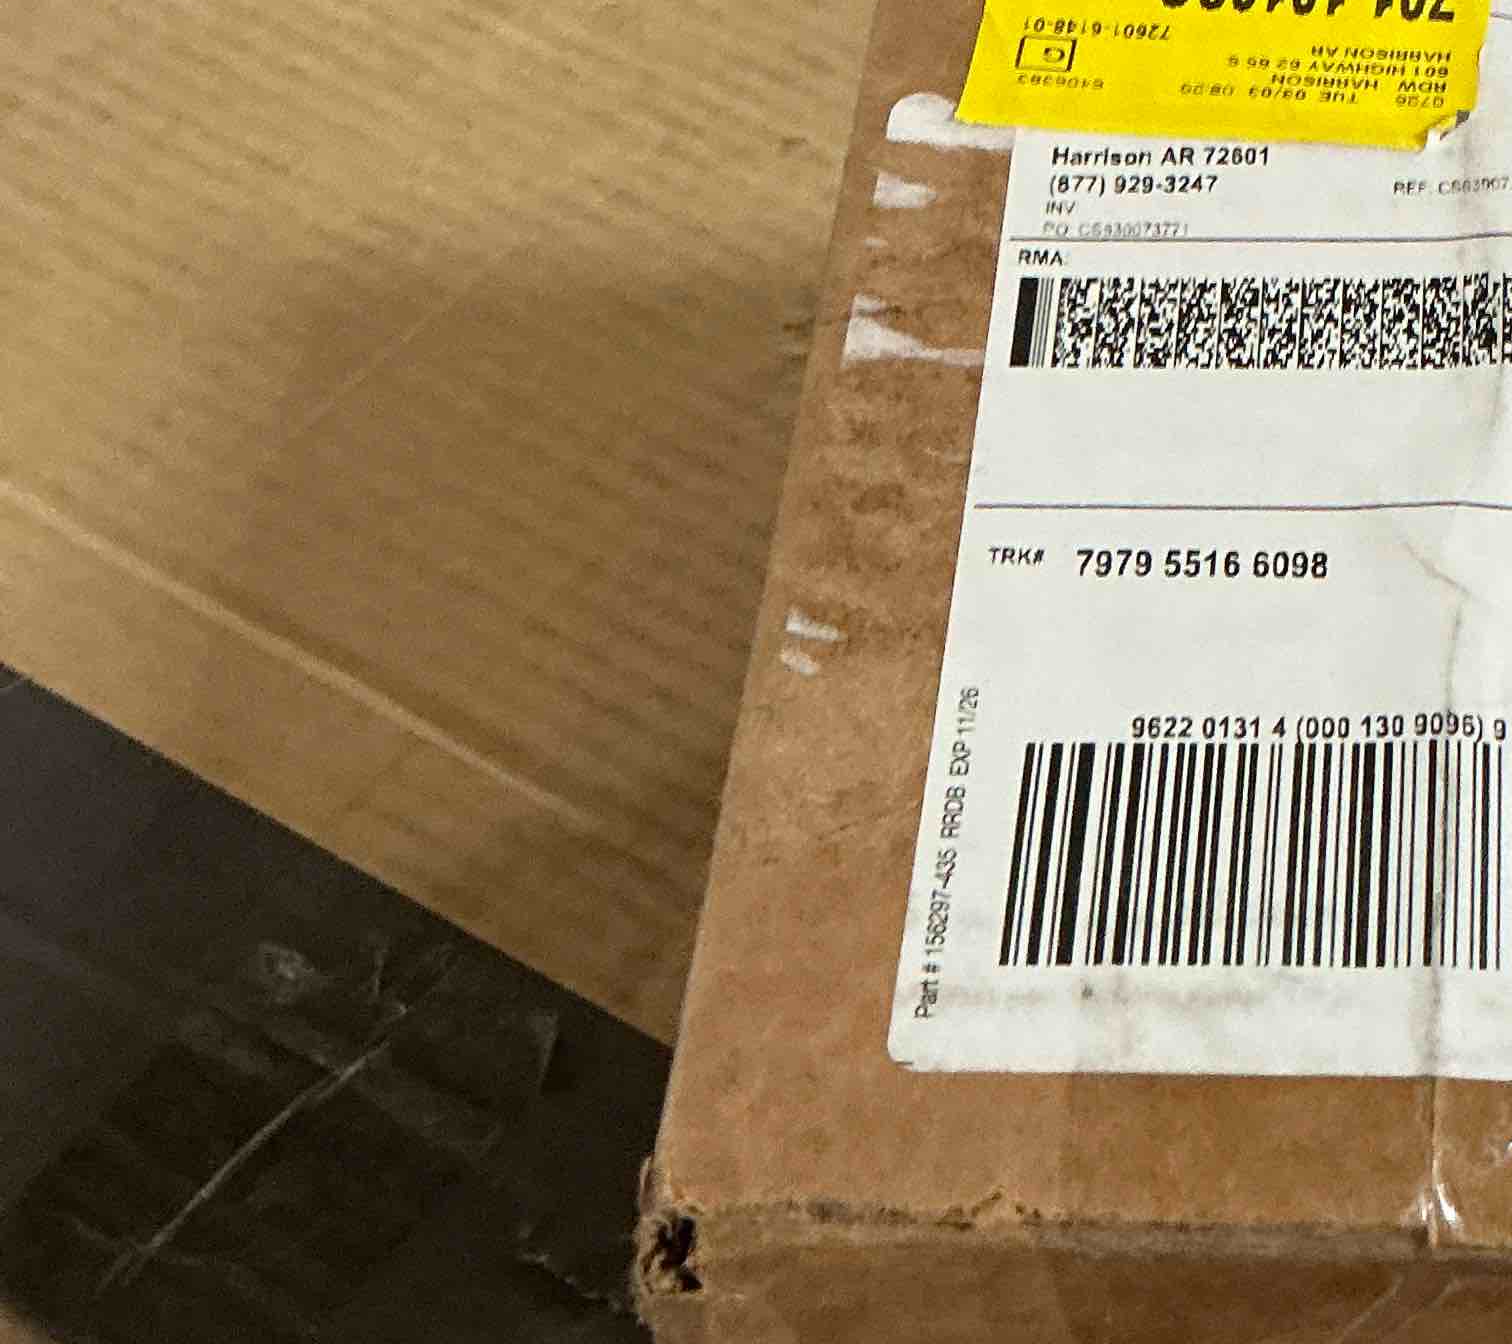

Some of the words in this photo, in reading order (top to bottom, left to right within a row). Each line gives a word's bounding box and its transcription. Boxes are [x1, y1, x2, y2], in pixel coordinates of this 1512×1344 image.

[1023, 15, 1172, 41] 72601-6148-01
[1310, 44, 1339, 58] AR
[1344, 47, 1452, 64] HARRISON
[1308, 60, 1406, 77] HIGHWAY
[1414, 65, 1450, 79] 601
[1271, 73, 1379, 91] HARRISON
[1397, 79, 1448, 94] RDW
[1319, 90, 1358, 105] TUE
[1051, 146, 1153, 167] Harrison
[1160, 146, 1195, 166] AR
[1204, 146, 1270, 166] 72601
[1049, 174, 1106, 198] (877)
[1113, 174, 1219, 194] 929-3247
[987, 547, 1045, 566] TRK#
[1076, 549, 1153, 578] 7979
[1164, 550, 1241, 578] 5516
[1252, 551, 1329, 579] 6098
[956, 685, 981, 736] 11/26
[1131, 714, 1193, 740] 9622
[1201, 715, 1260, 739] 0131
[1271, 715, 1287, 738] 4
[1296, 713, 1350, 744] (000
[1360, 713, 1405, 739] 130
[1413, 711, 1484, 744] 9096)
[949, 740, 972, 778] EXP
[925, 848, 958, 956] 156297-435
[914, 978, 939, 1020] Part
